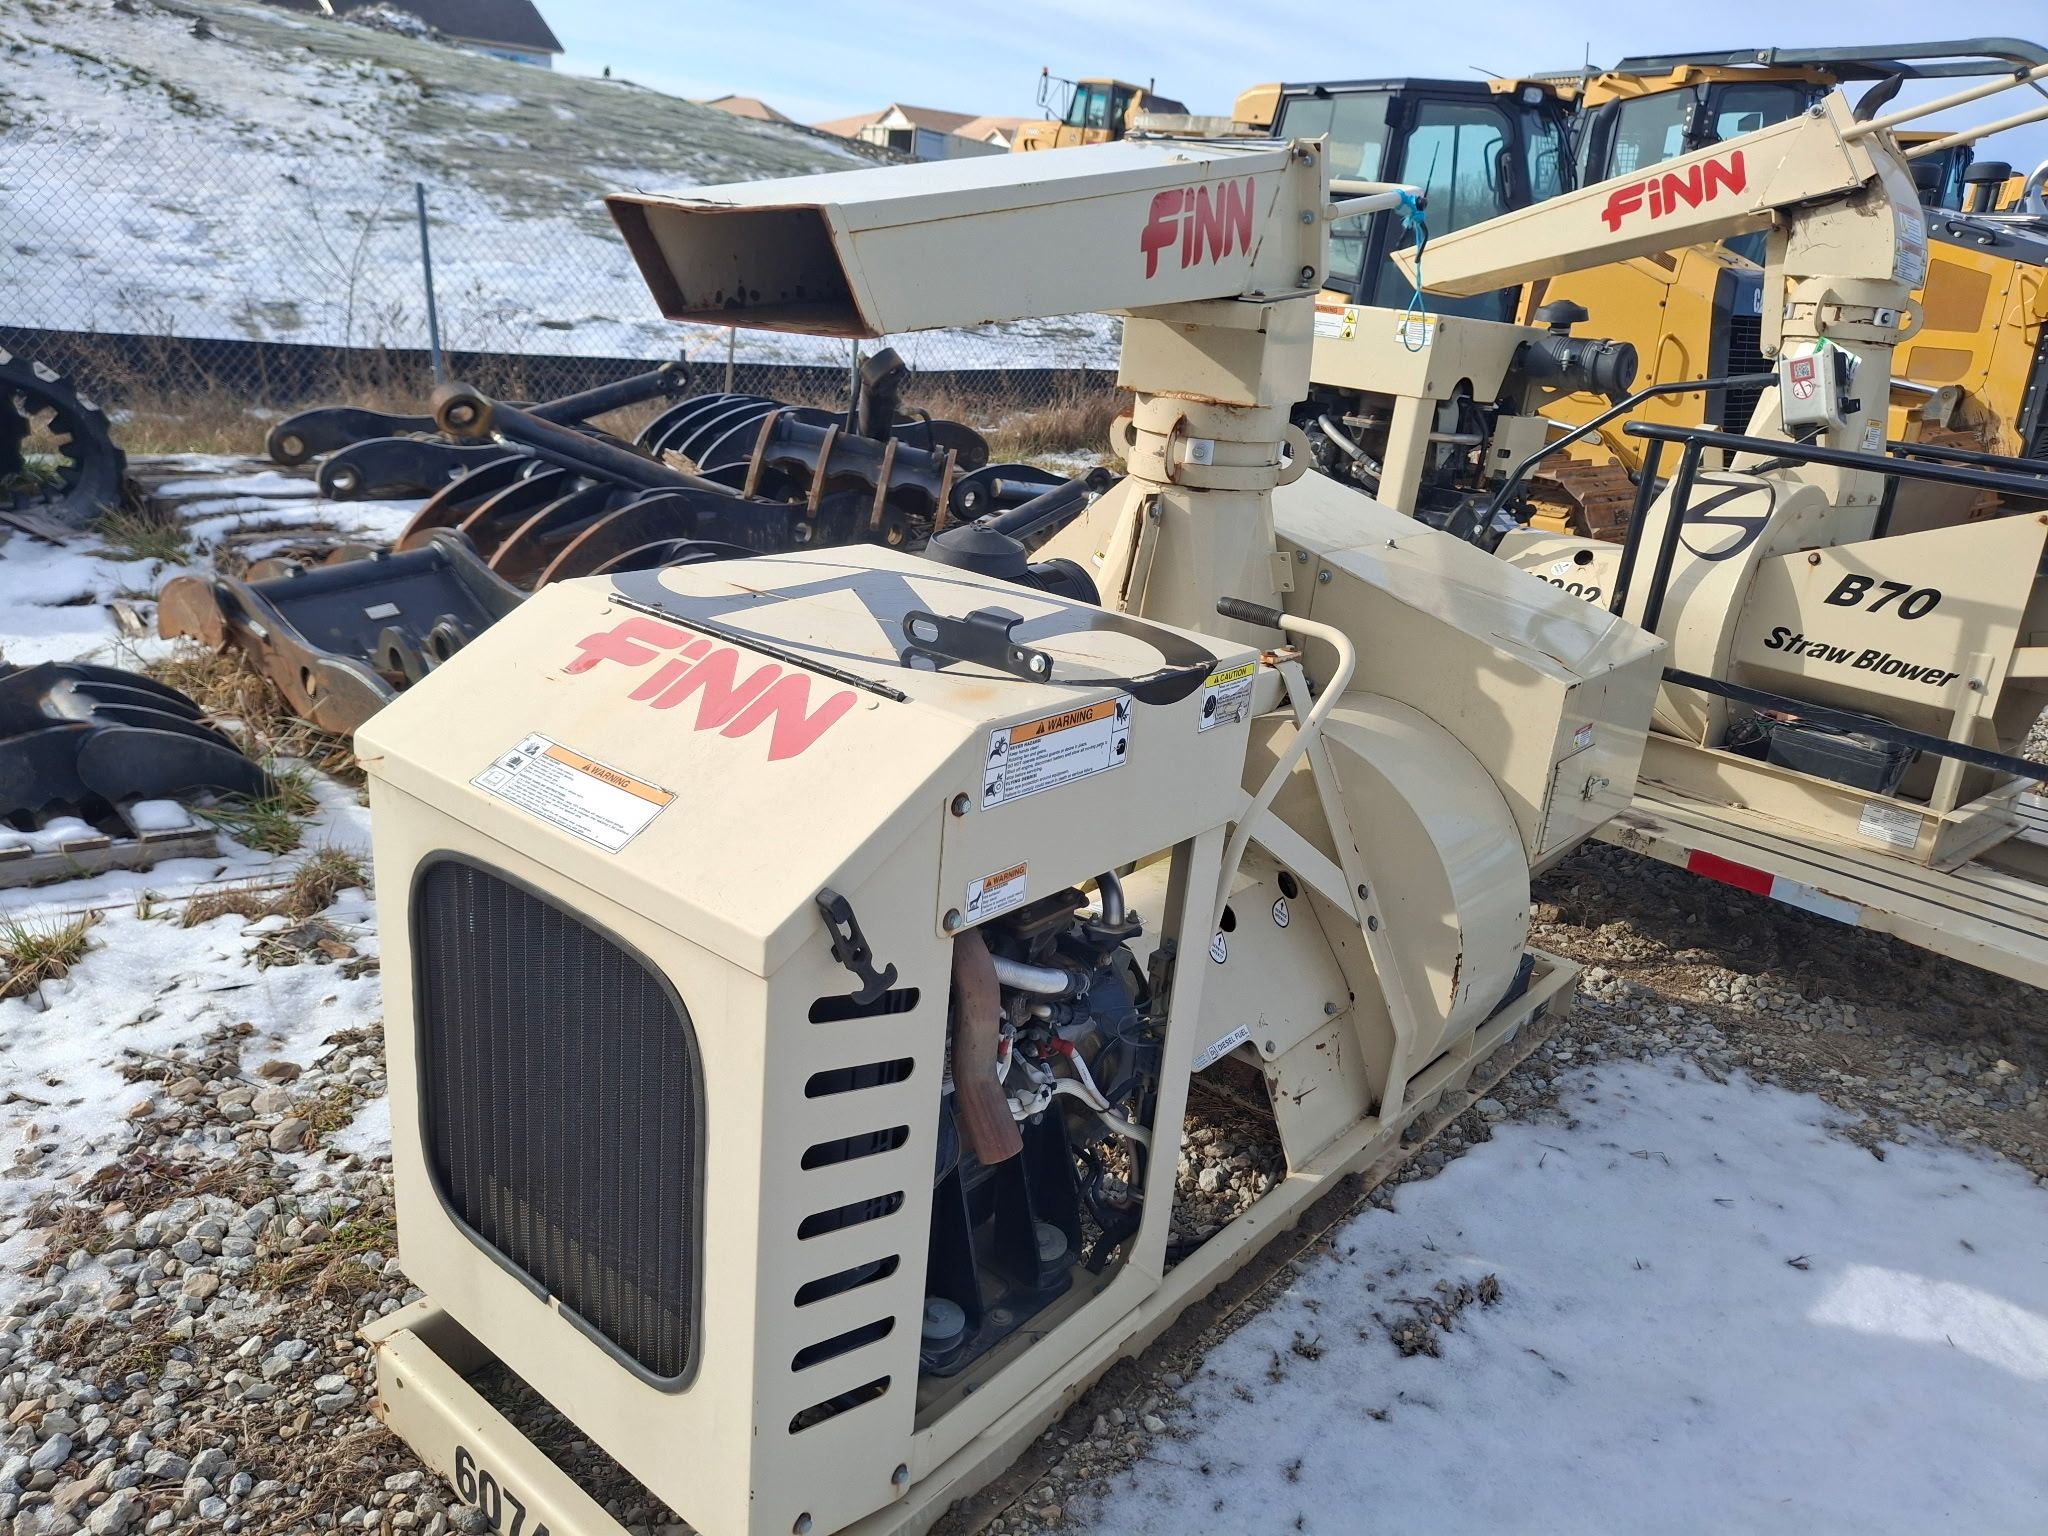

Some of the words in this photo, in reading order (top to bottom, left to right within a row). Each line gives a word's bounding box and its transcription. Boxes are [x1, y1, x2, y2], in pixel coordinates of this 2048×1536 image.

[1823, 573, 1942, 620] B70
[1763, 626, 1855, 664] Straw
[1851, 649, 1960, 688] Blower
[1220, 667, 1247, 682] CAUTION
[1047, 708, 1094, 732] WARNING
[590, 766, 631, 788] WARNING
[993, 866, 1025, 885] WARNING
[1217, 1036, 1236, 1052] DIESEL
[1234, 1028, 1249, 1041] FUEL
[455, 1445, 550, 1536] 607
